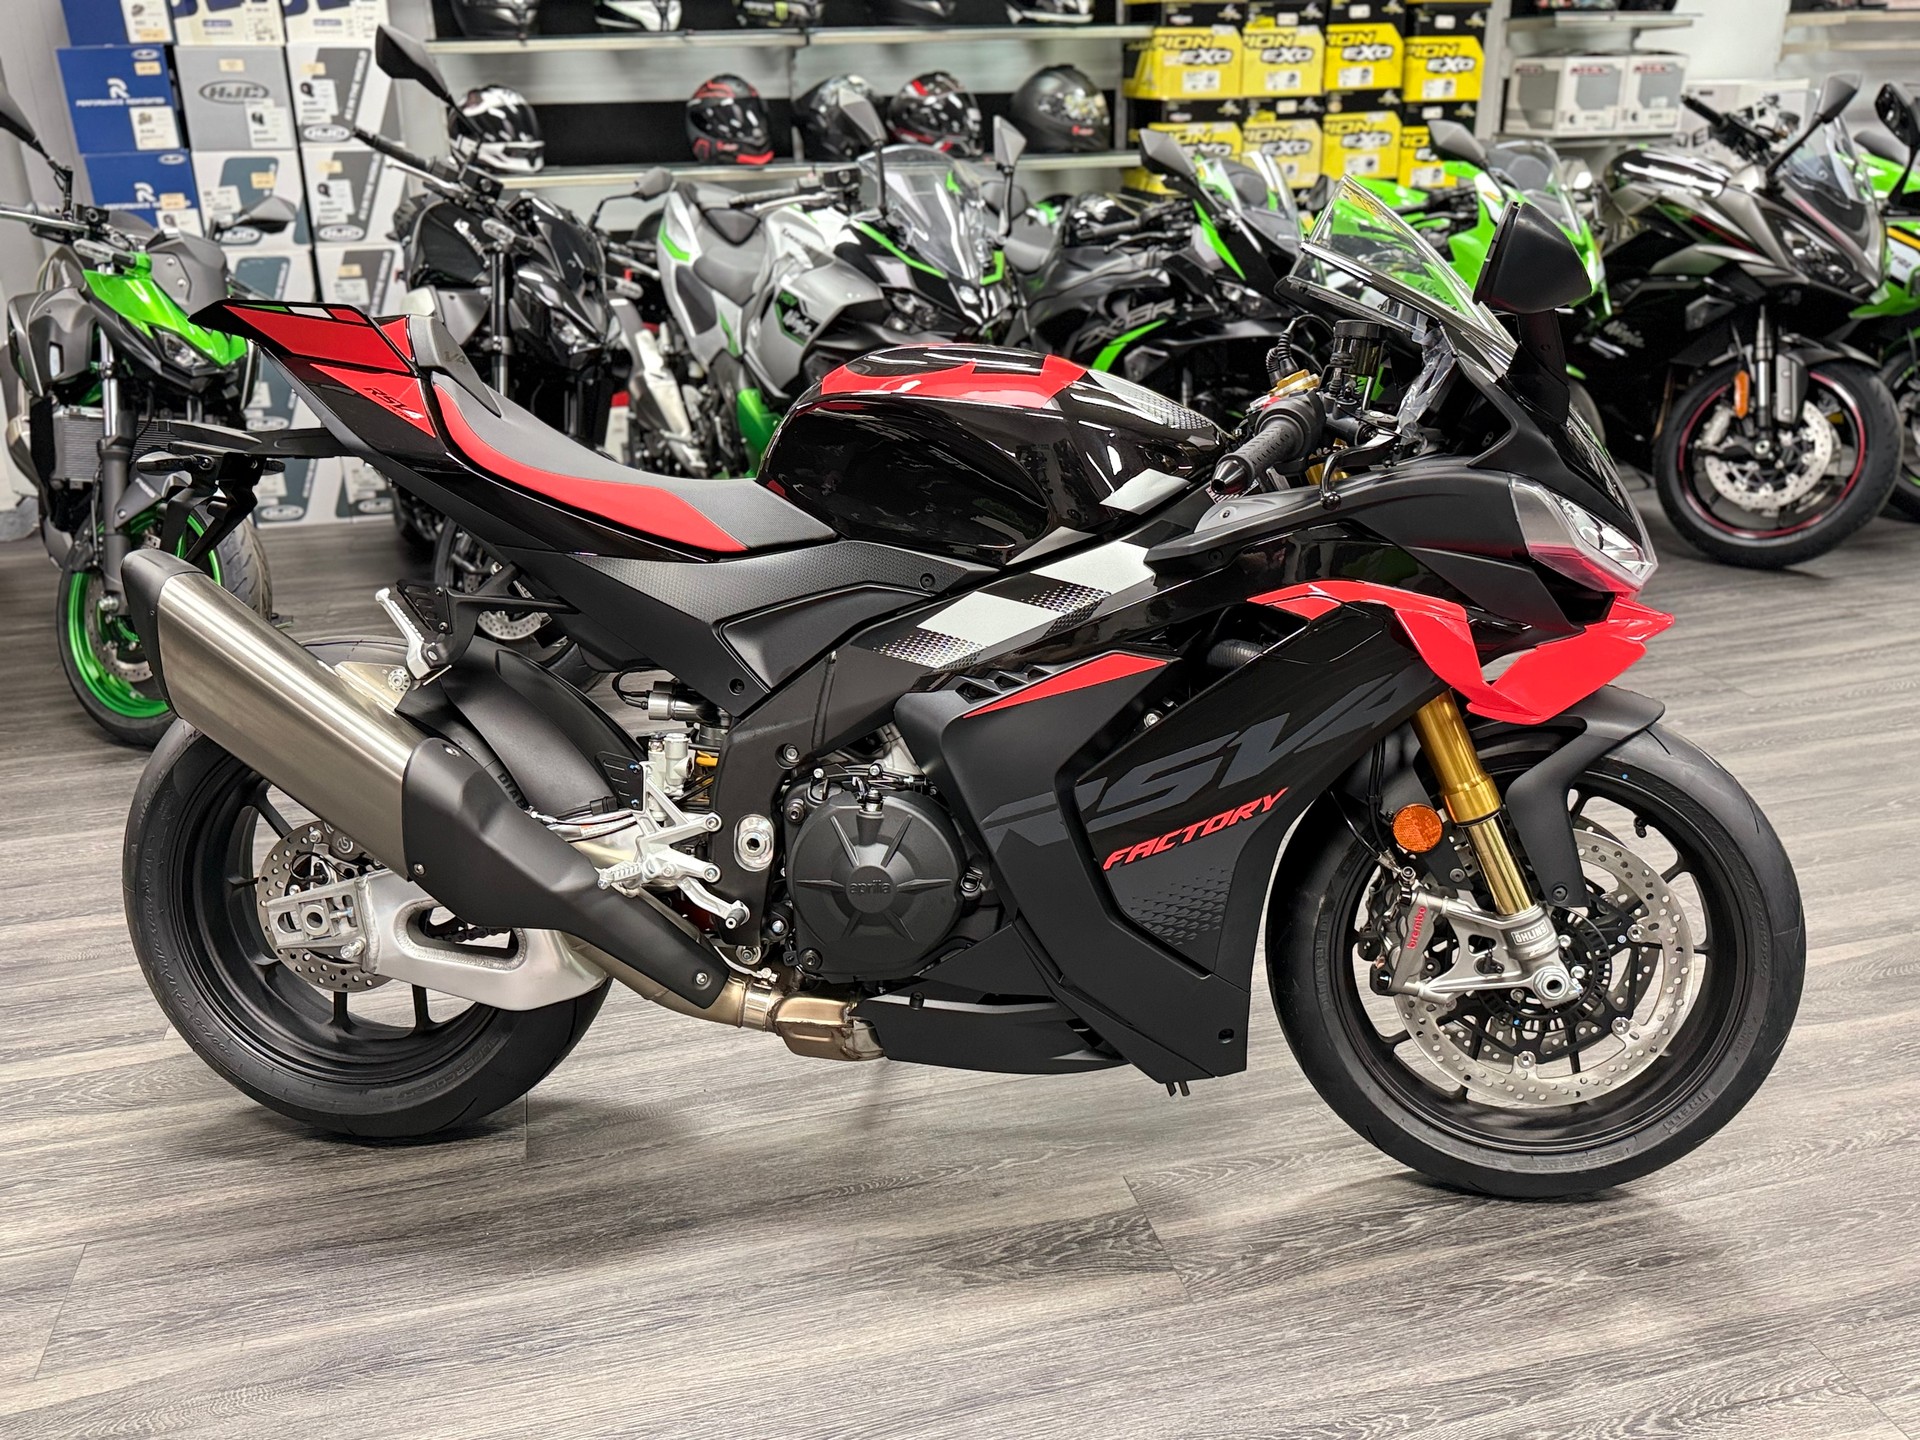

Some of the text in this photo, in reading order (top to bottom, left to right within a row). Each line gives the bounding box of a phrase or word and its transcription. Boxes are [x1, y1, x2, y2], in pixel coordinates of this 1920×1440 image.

[1179, 49, 1233, 65] EXO
[1261, 48, 1314, 64] EXO
[1342, 45, 1394, 61] EXO
[1426, 56, 1476, 73] EXO
[208, 86, 261, 99] HJC
[1103, 786, 1289, 872] FACTORY
[850, 879, 891, 898] aprilia
[1406, 905, 1428, 950] brembo
